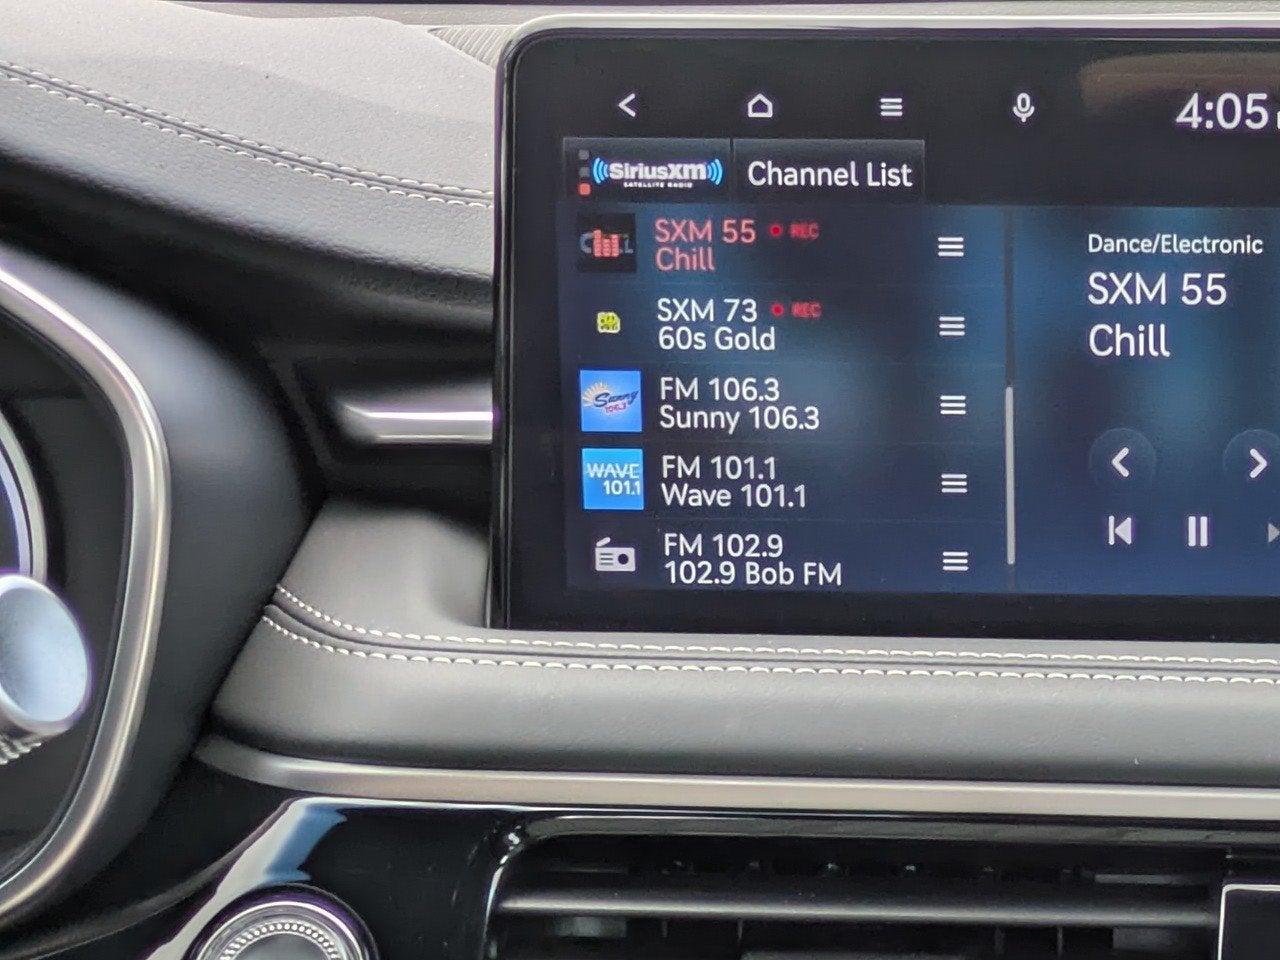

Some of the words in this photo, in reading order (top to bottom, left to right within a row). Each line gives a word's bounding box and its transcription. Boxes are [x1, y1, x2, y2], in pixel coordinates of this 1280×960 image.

[1175, 93, 1269, 130] 4:05
[747, 160, 859, 187] Channel
[866, 162, 913, 187] List
[655, 218, 713, 244] SXM
[722, 219, 757, 244] 55
[789, 222, 820, 240] REC
[1088, 233, 1264, 256] Dance/Electronic
[655, 246, 716, 272] Chill
[1088, 272, 1167, 306] SXM
[1181, 274, 1227, 306] 55
[657, 297, 715, 323] SXM
[724, 298, 758, 323] 73
[792, 302, 823, 319] REC
[658, 326, 707, 351] 60s
[714, 326, 776, 351] Gold
[1088, 323, 1171, 358] Chill
[659, 376, 698, 400] FM
[708, 377, 780, 402] 106.3
[659, 404, 740, 435] Sunny
[748, 405, 820, 430] 106.3
[587, 463, 640, 479] WAVE
[662, 456, 700, 480] FM
[710, 456, 777, 481] 101.1
[603, 480, 641, 496] 101.1
[661, 483, 732, 508] Wave
[740, 484, 807, 509] 101.1
[664, 533, 702, 558] FM
[712, 534, 783, 559] 102.9
[664, 560, 736, 586] 102.9
[745, 562, 794, 586] Bob
[803, 562, 843, 587] FM
